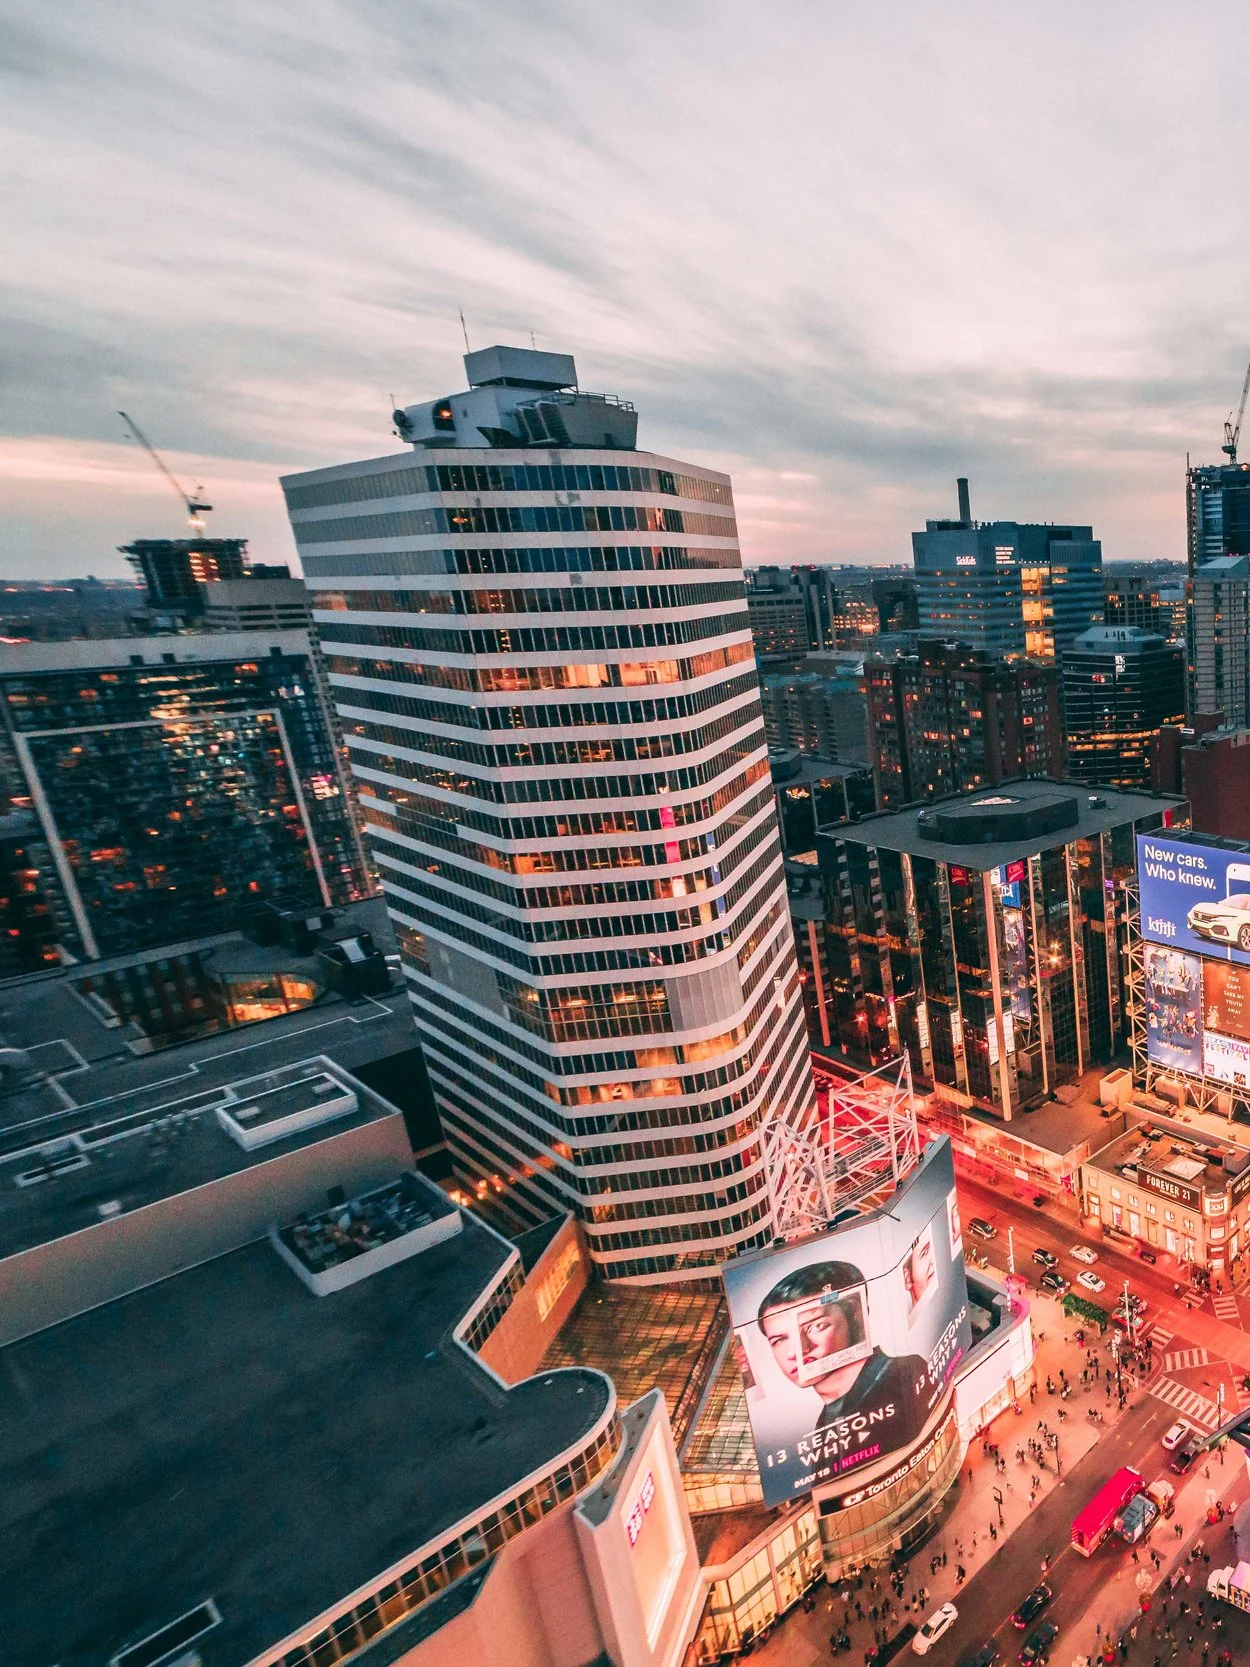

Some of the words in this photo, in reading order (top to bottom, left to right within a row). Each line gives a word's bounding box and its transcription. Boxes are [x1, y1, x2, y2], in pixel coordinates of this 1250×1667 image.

[1144, 844, 1175, 863] New
[1176, 853, 1208, 870] cars.
[1144, 861, 1176, 882] Who
[1178, 867, 1217, 890] knew.
[1147, 916, 1177, 938] kijiji
[1225, 998, 1243, 1007] YOUTH
[1146, 1174, 1180, 1198] FOREVER
[1182, 1190, 1191, 1201] 21
[915, 1374, 925, 1395] 13
[927, 1305, 967, 1376] REASONS
[929, 1345, 951, 1385] WHY
[766, 1448, 788, 1469] 13
[796, 1403, 896, 1455] REASONS
[799, 1435, 853, 1468] WHY
[793, 1475, 816, 1490] MAY
[816, 1467, 831, 1479] 18
[841, 1443, 881, 1470] NETFLIX
[866, 1464, 909, 1497] Toronto
[909, 1439, 935, 1469] Eaton
